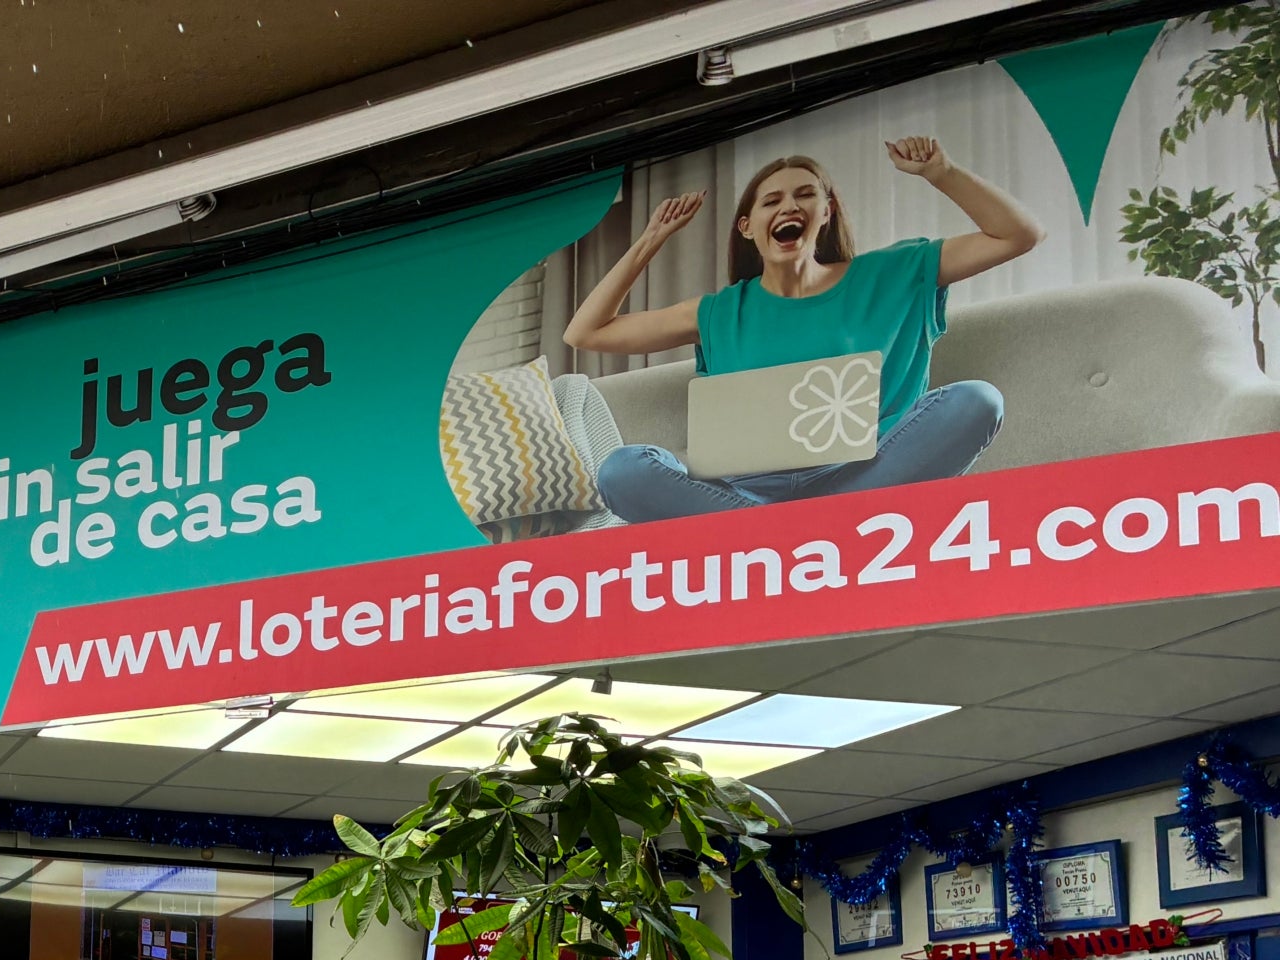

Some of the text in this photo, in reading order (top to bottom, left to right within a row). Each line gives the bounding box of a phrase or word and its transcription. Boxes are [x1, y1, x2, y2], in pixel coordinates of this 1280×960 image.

[69, 331, 332, 459] juega
[76, 419, 241, 503] salir
[29, 475, 322, 567] de casa
[34, 482, 1280, 686] www.loteriafortuna24.com
[1055, 872, 1097, 888] 00750
